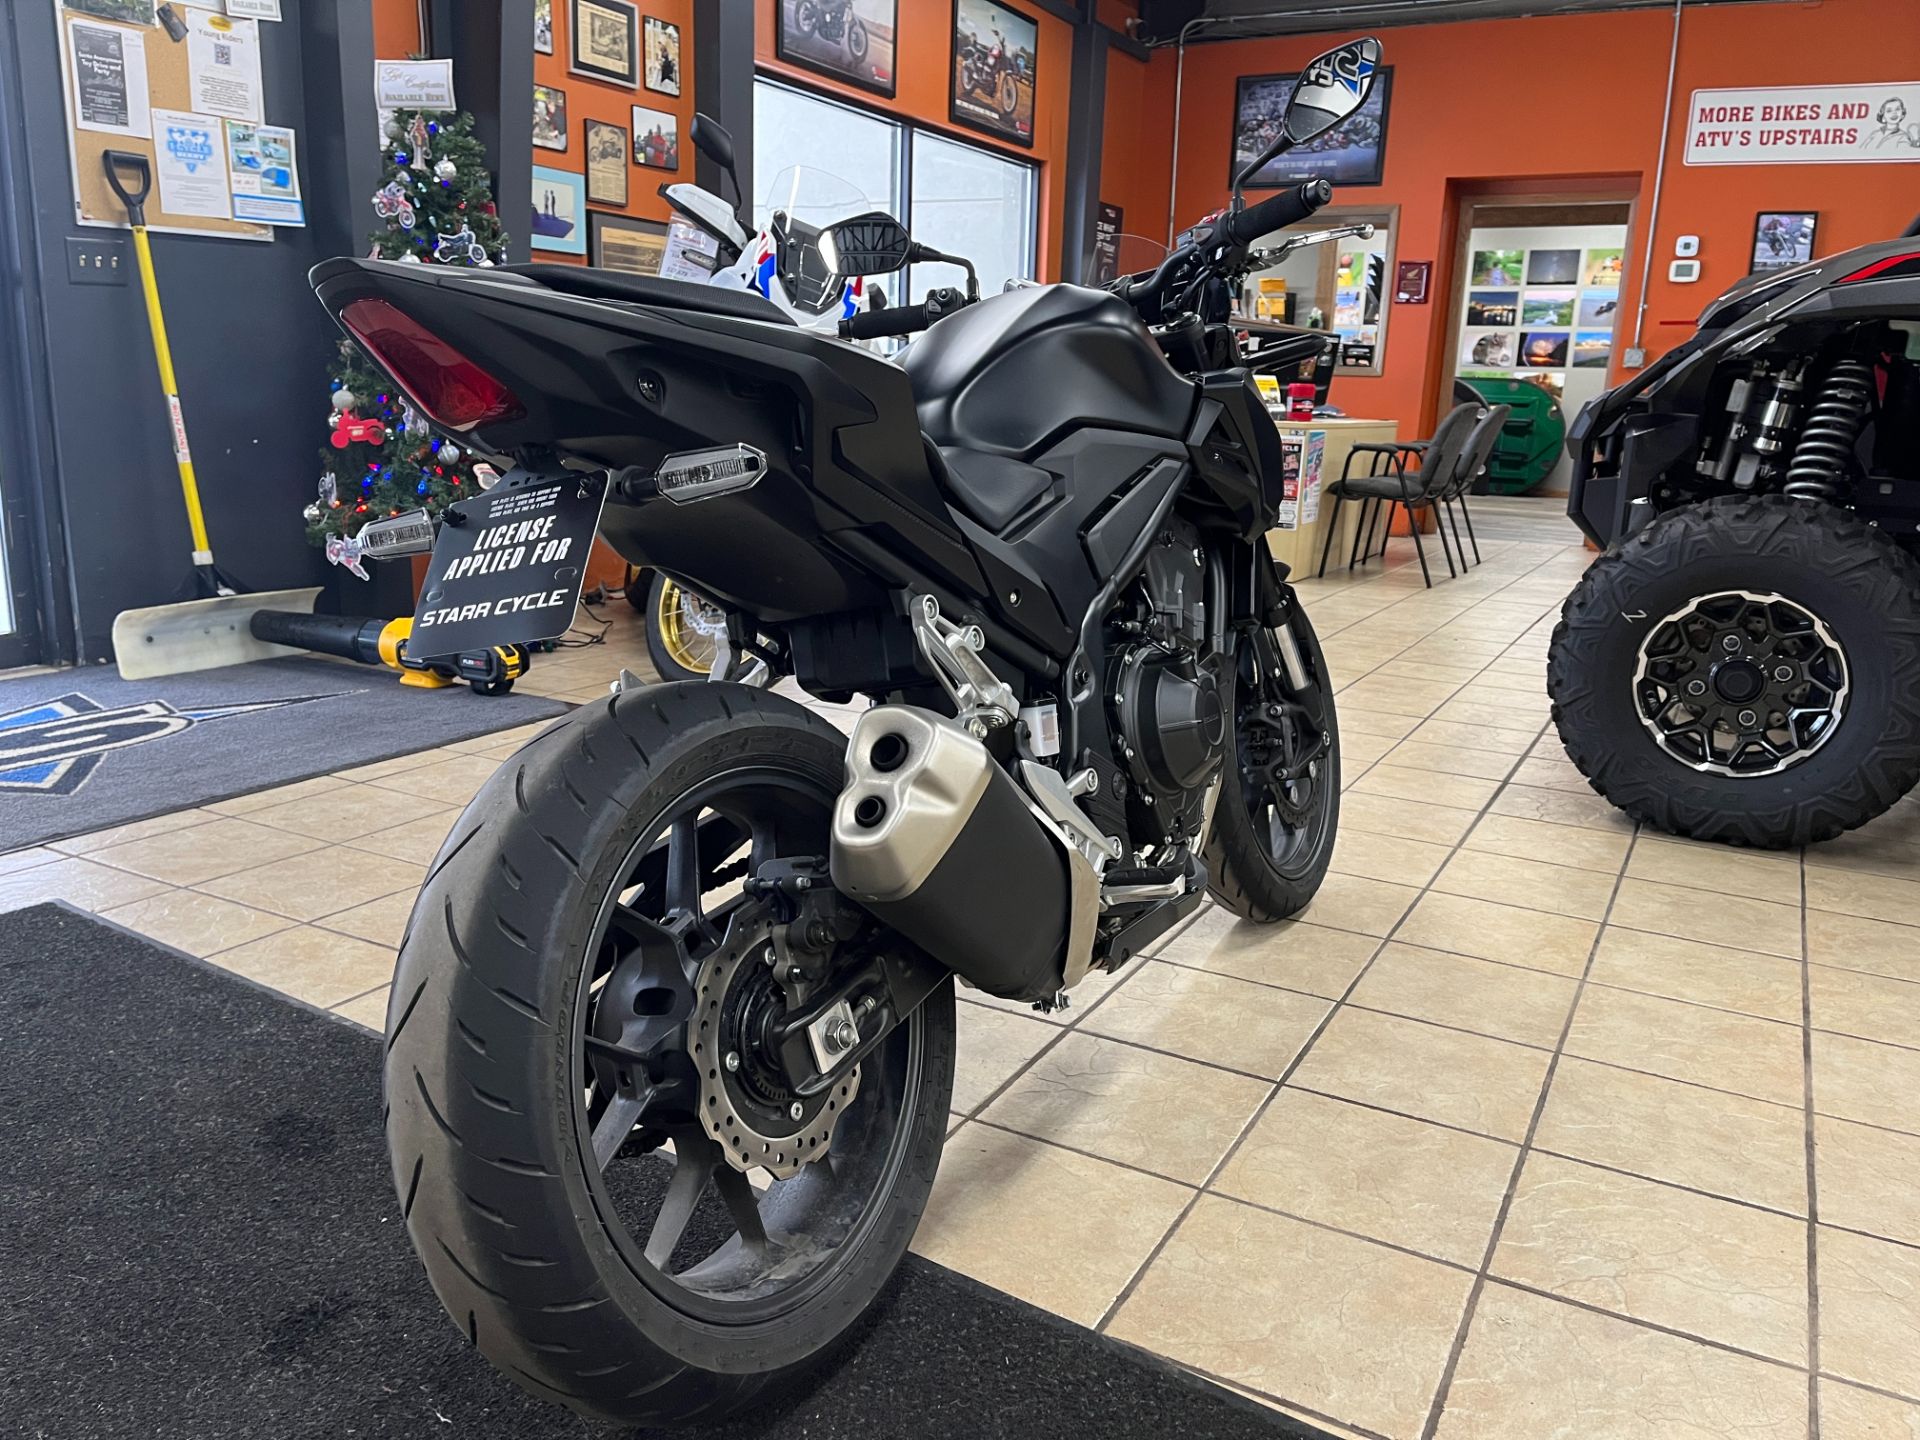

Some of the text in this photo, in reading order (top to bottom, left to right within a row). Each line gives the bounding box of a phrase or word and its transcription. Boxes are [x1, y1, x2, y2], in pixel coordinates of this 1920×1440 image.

[1698, 102, 1870, 124] MORE BIKES AND
[1695, 127, 1858, 148] ATV'S UPSTAIRS
[472, 514, 557, 551] LICENSE
[442, 537, 573, 582] APPLIED FOR
[419, 588, 569, 628] STARR CYCLE
